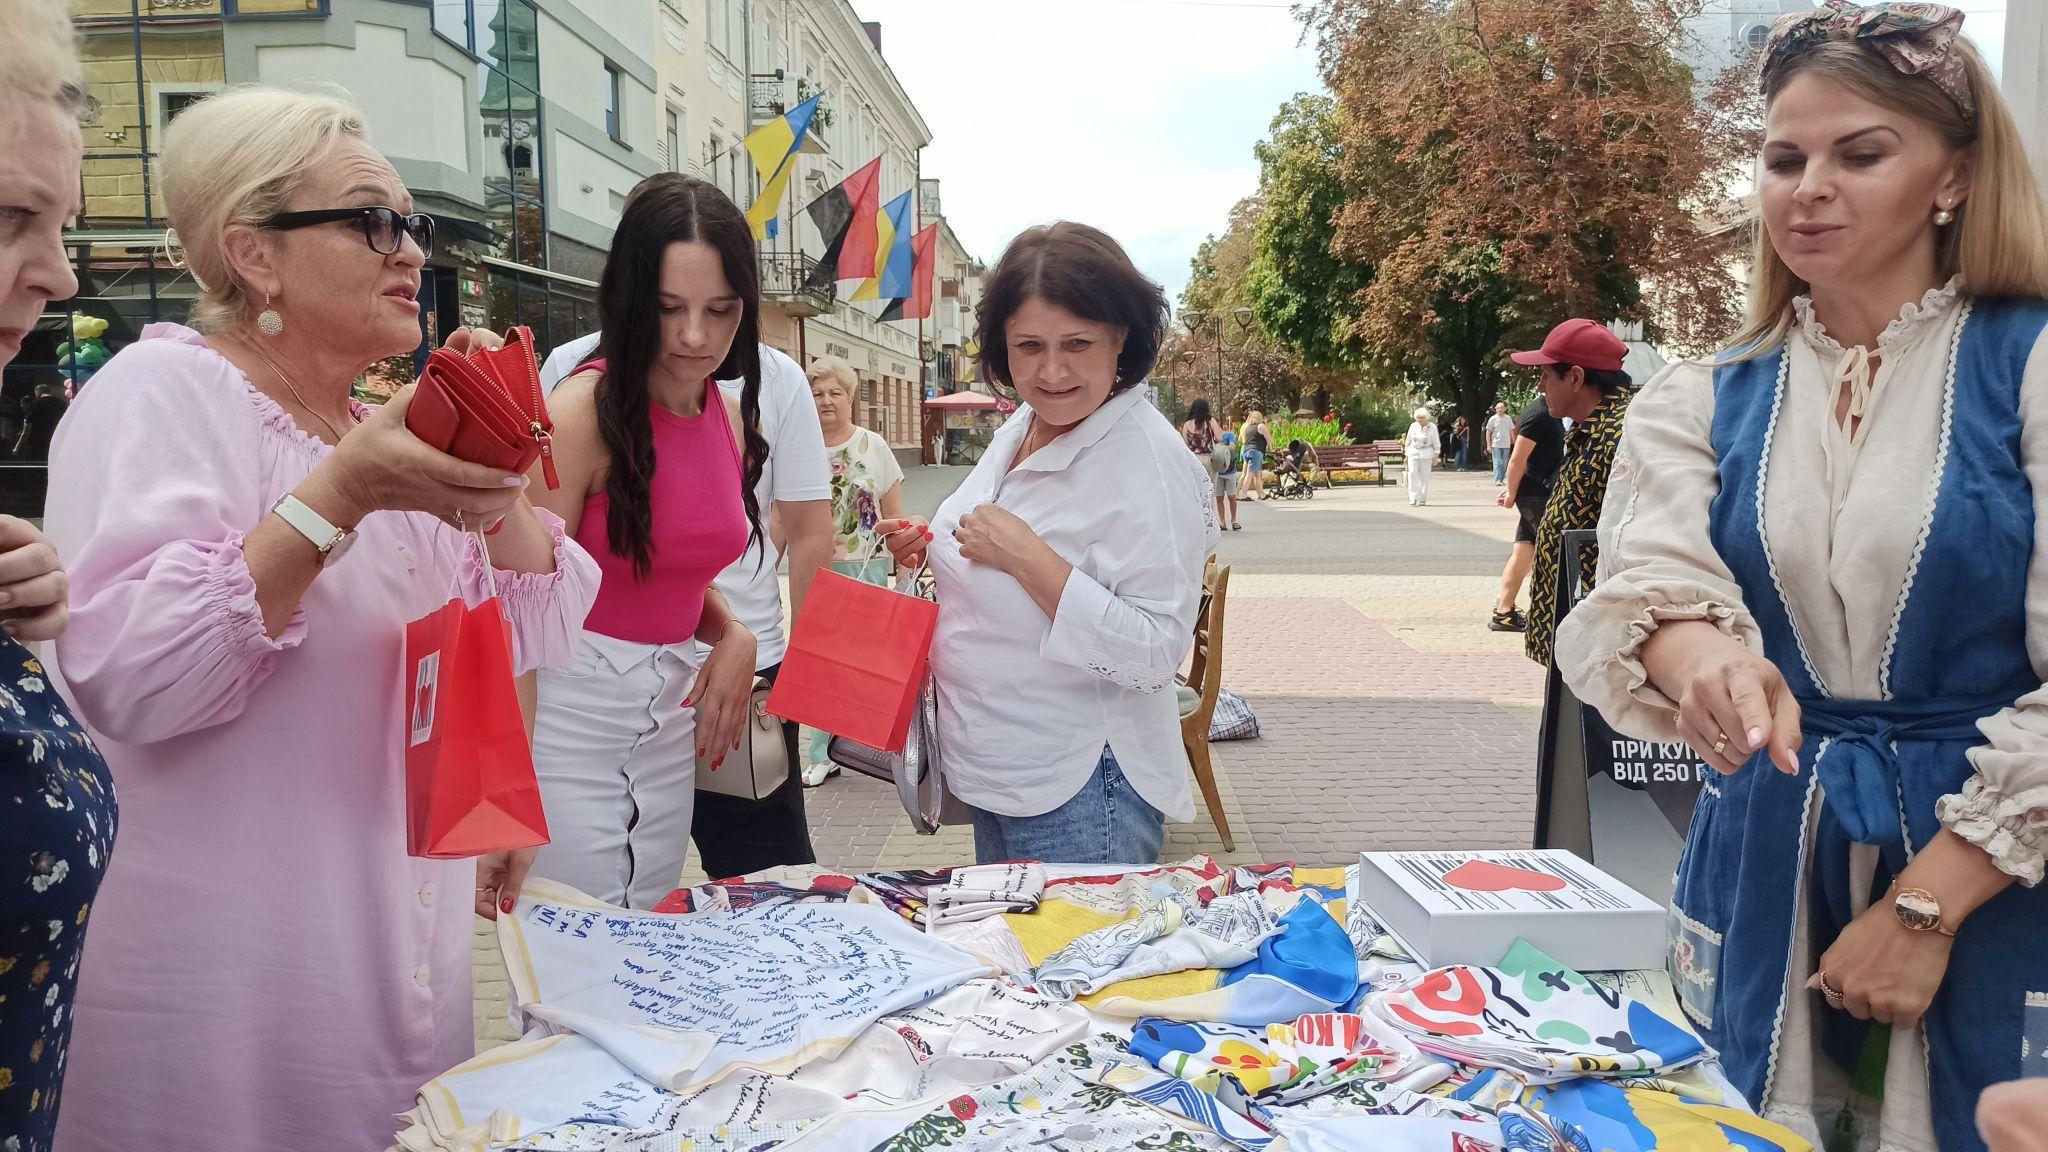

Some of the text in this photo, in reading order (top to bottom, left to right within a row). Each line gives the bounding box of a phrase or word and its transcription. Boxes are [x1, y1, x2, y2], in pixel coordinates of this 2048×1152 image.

[1612, 741, 1653, 759] ПРИ
[1614, 762, 1648, 783] ВІД
[1652, 763, 1689, 782] 250
[1432, 890, 1516, 910] LOVE
[1521, 891, 1573, 910] ME
